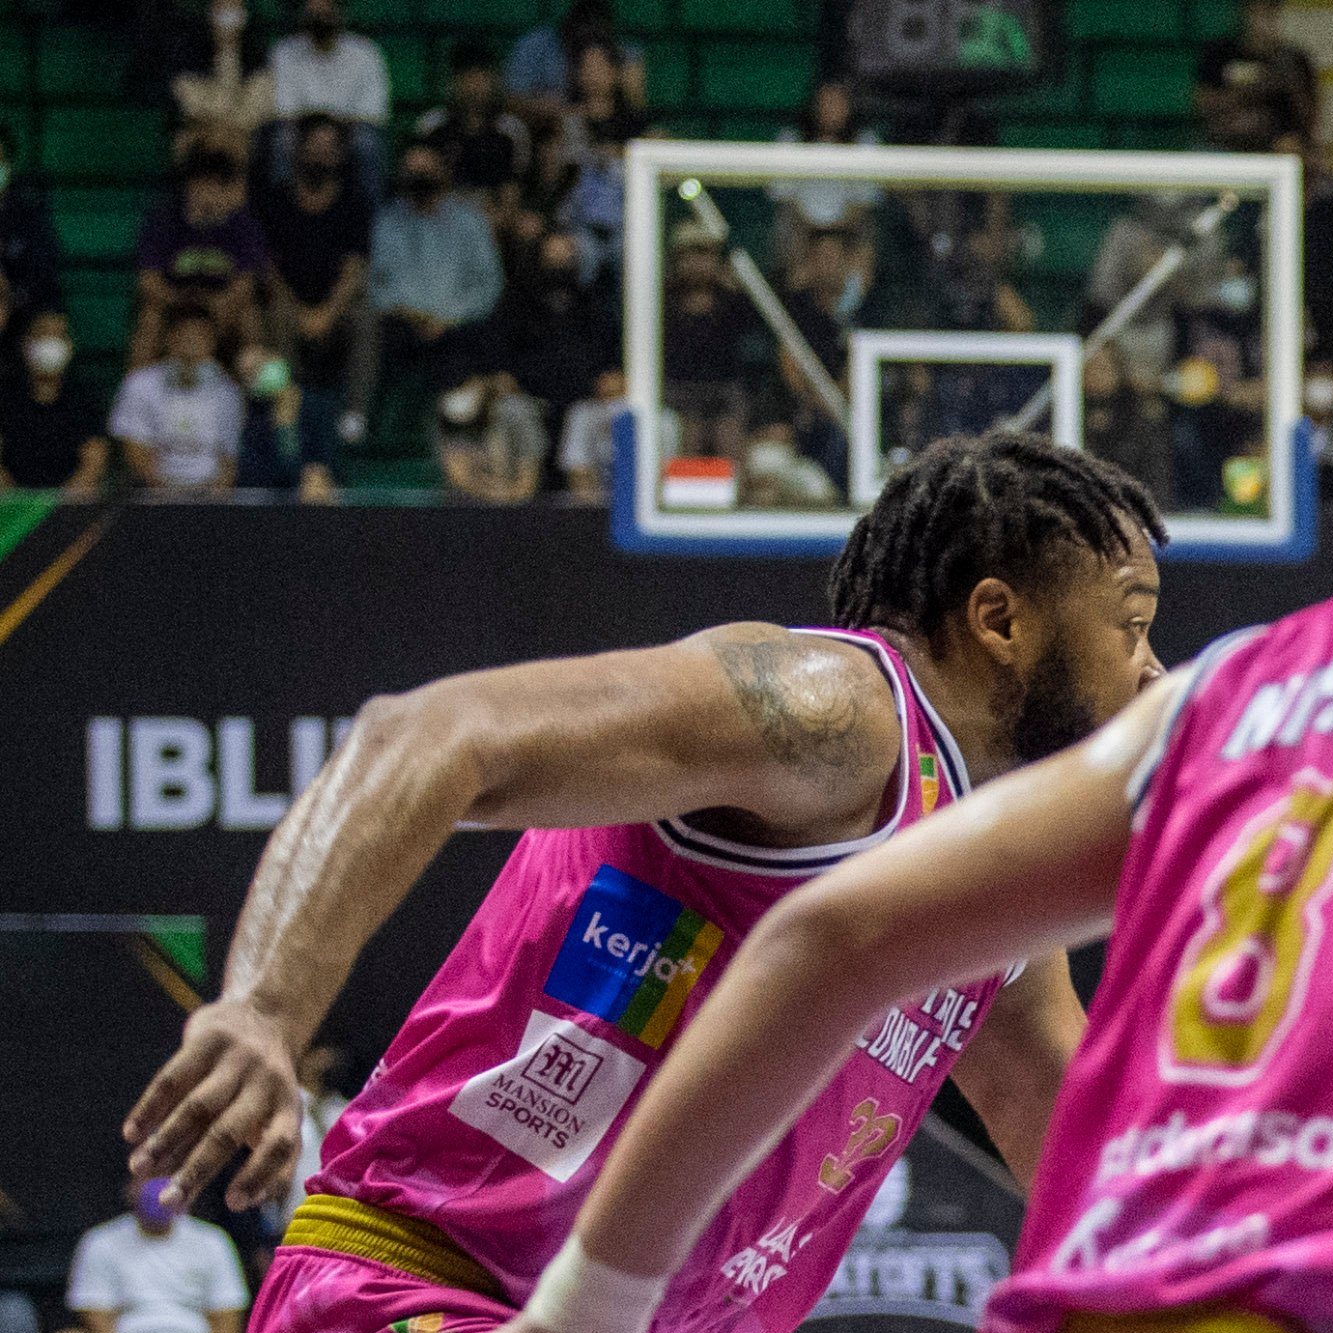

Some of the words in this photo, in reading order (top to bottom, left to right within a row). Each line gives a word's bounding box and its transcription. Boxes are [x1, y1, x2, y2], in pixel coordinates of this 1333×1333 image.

[87, 714, 351, 832] IBLI
[485, 1091, 570, 1150] SPORTS
[492, 1073, 586, 1135] MANSION
